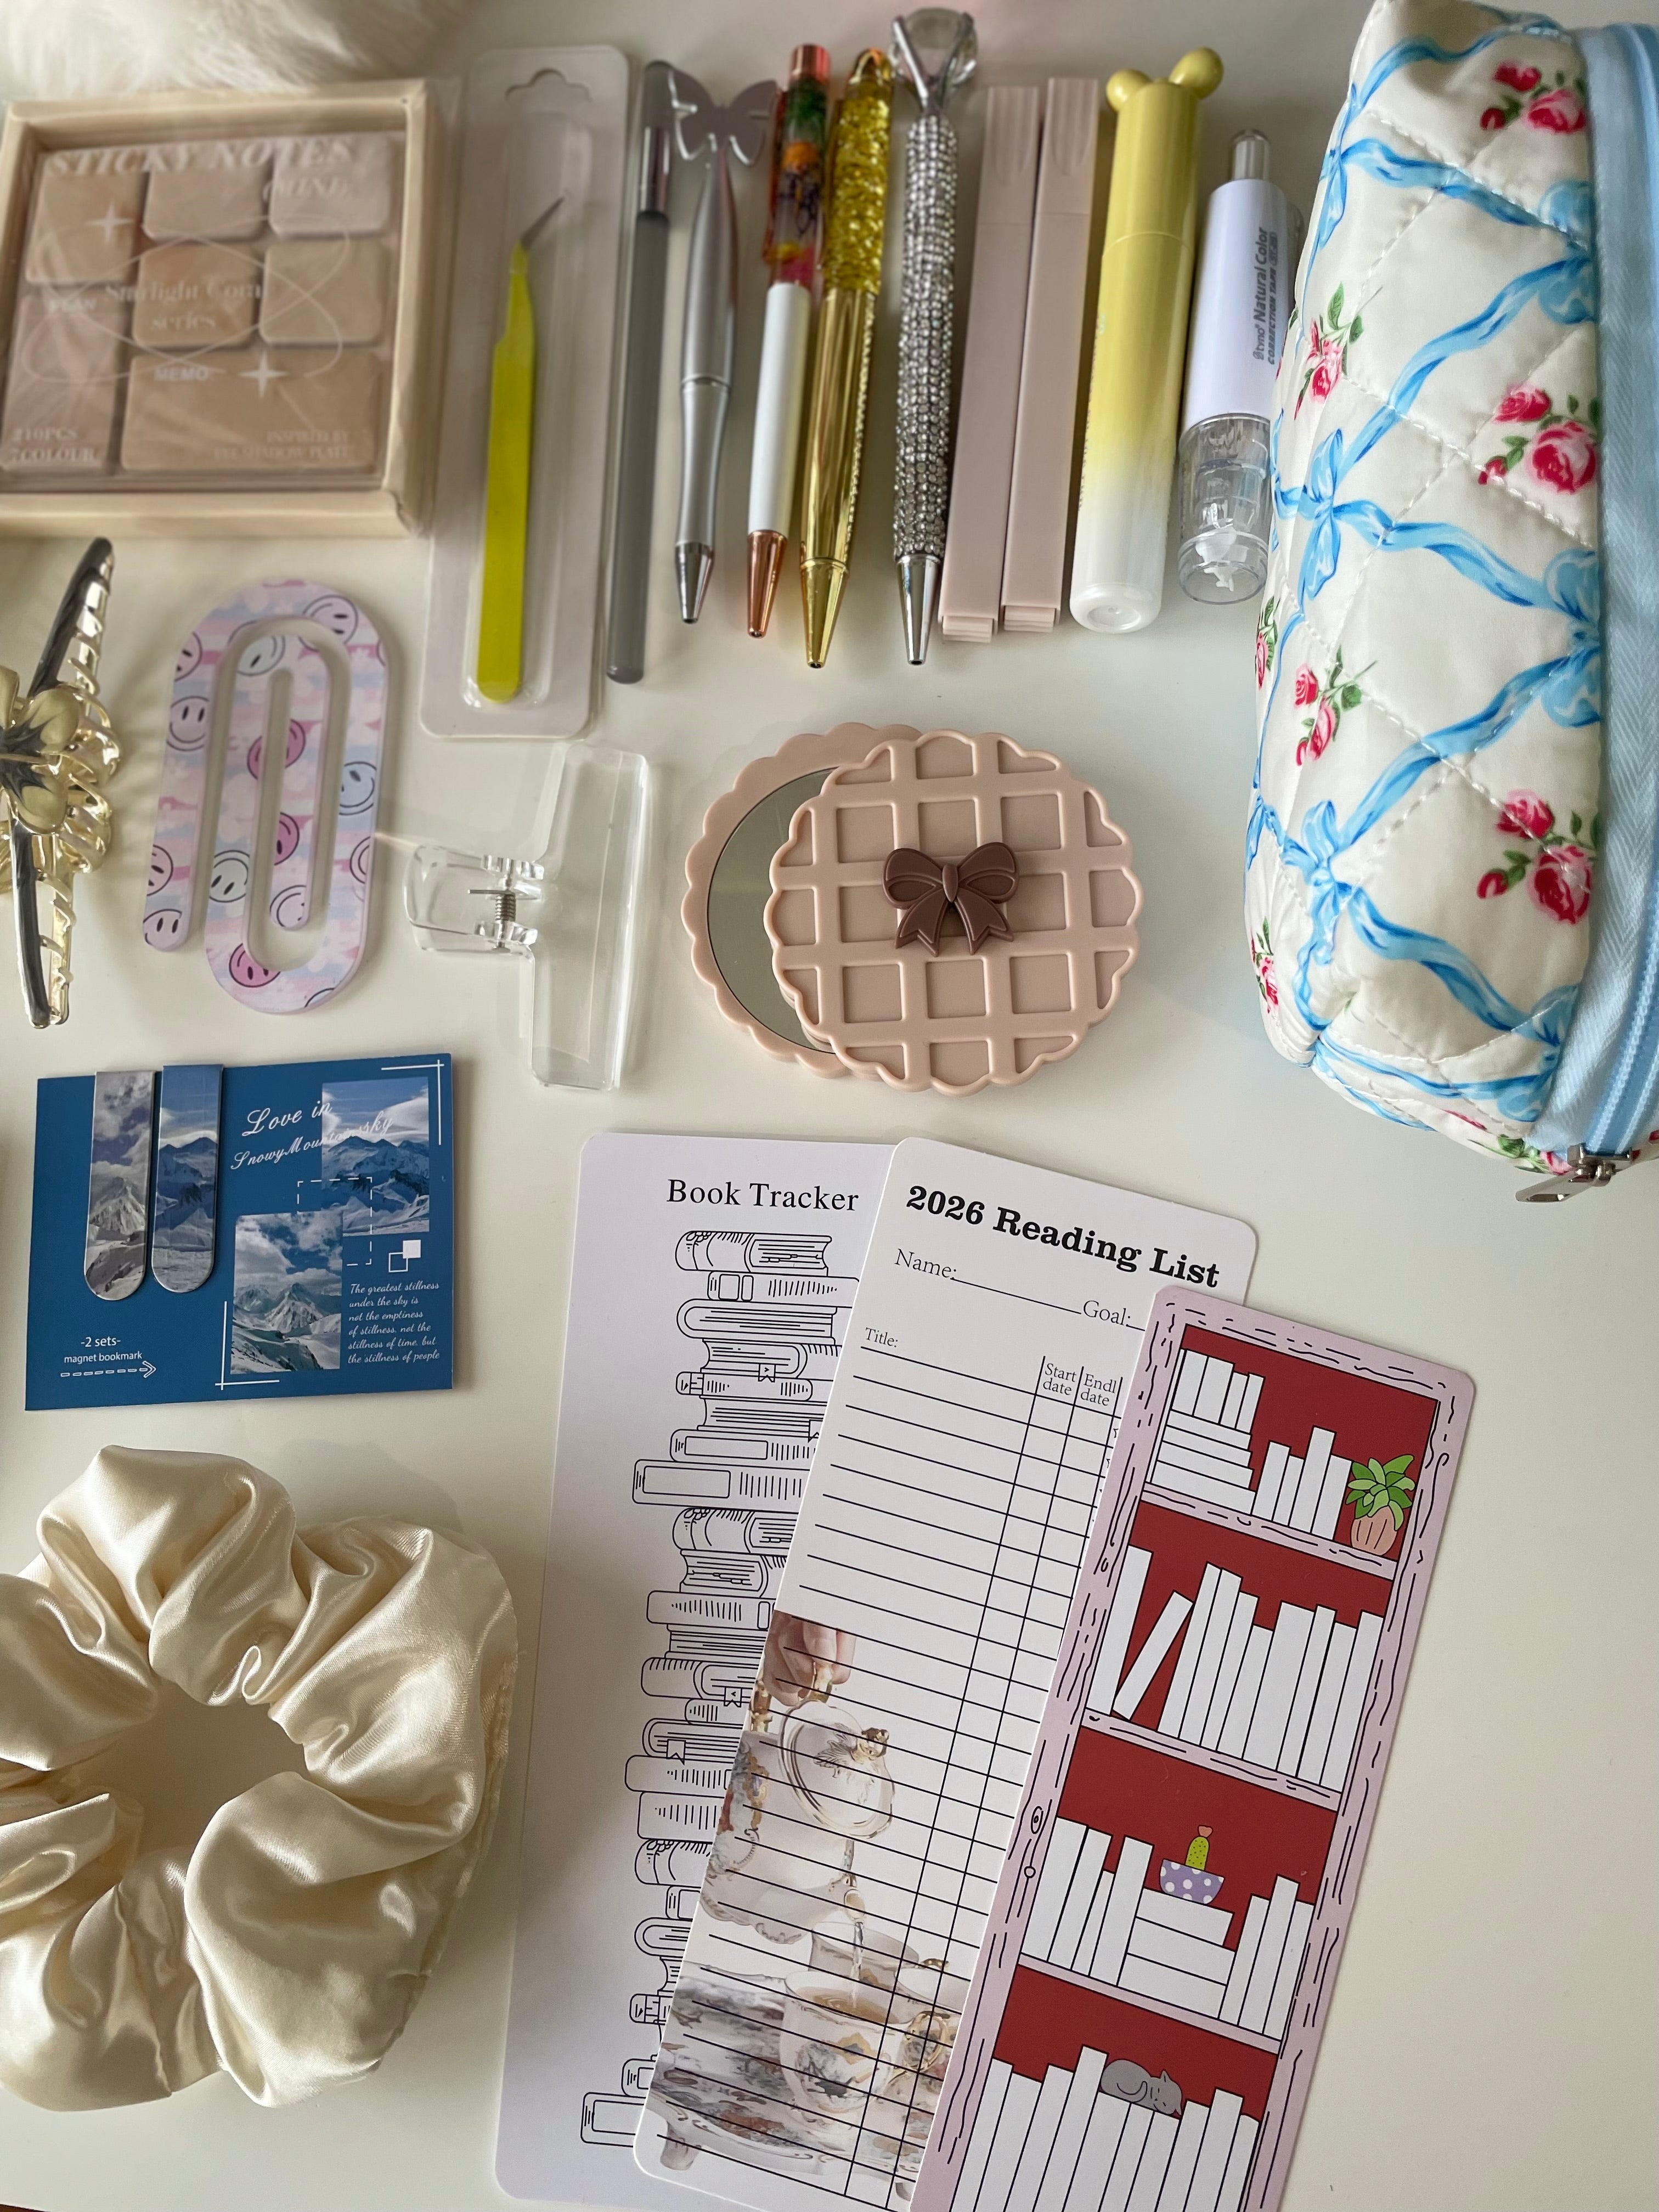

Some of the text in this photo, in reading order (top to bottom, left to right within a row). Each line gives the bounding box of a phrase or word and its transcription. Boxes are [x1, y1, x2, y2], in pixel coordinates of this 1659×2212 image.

[49, 136, 356, 177] STICKY NOTES
[1255, 227, 1268, 266] Color
[1269, 267, 1277, 294] TAPE
[1253, 266, 1267, 323] Natural
[151, 314, 217, 330] series
[1267, 295, 1277, 365] CORRECTION
[154, 367, 211, 382] MEMO
[242, 1100, 332, 1137] Love in
[667, 1179, 860, 1211] Book Tracker
[906, 1185, 1220, 1288] 2026 Reading List
[894, 1248, 957, 1280] Name:
[351, 1280, 439, 1295] The greatest stillness
[349, 1297, 374, 1307] under
[377, 1296, 391, 1306] the
[393, 1295, 408, 1307] sky
[349, 1311, 423, 1322] not the emptiness
[1083, 1300, 1131, 1327] Goal:
[349, 1325, 359, 1338] of
[400, 1323, 414, 1333] not
[417, 1322, 431, 1331] the
[865, 1327, 898, 1348] Title:
[81, 1336, 121, 1347] -2 sets-
[348, 1339, 383, 1350] stillness
[386, 1337, 396, 1350] of
[422, 1335, 436, 1346] but
[64, 1351, 143, 1365] magnet bookmark
[348, 1349, 439, 1363] the stillness of people
[1045, 1363, 1077, 1383] Start
[1043, 1378, 1072, 1396] date
[1080, 1388, 1109, 1406] date
